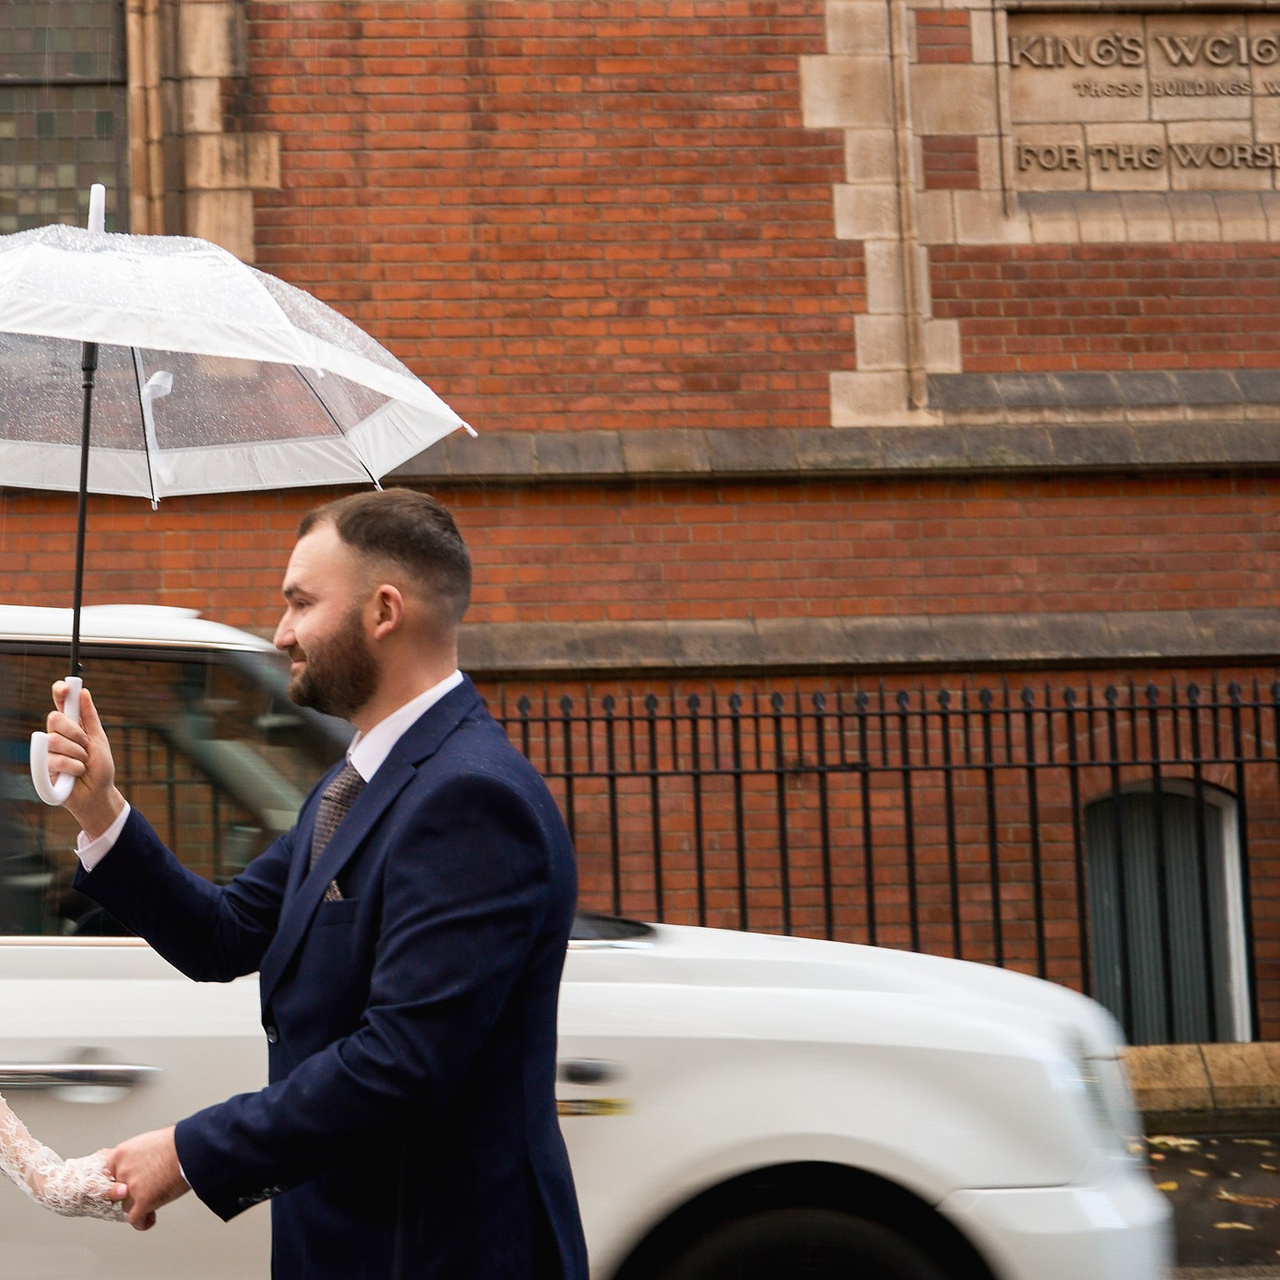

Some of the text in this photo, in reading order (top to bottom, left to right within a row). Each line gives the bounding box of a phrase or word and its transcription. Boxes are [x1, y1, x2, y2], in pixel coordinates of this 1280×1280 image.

[1010, 32, 1147, 67] KING'S
[1072, 81, 1144, 98] THESE
[1152, 81, 1252, 97] BUILDINGS
[1017, 144, 1085, 171] FOR
[1090, 144, 1163, 171] THE
